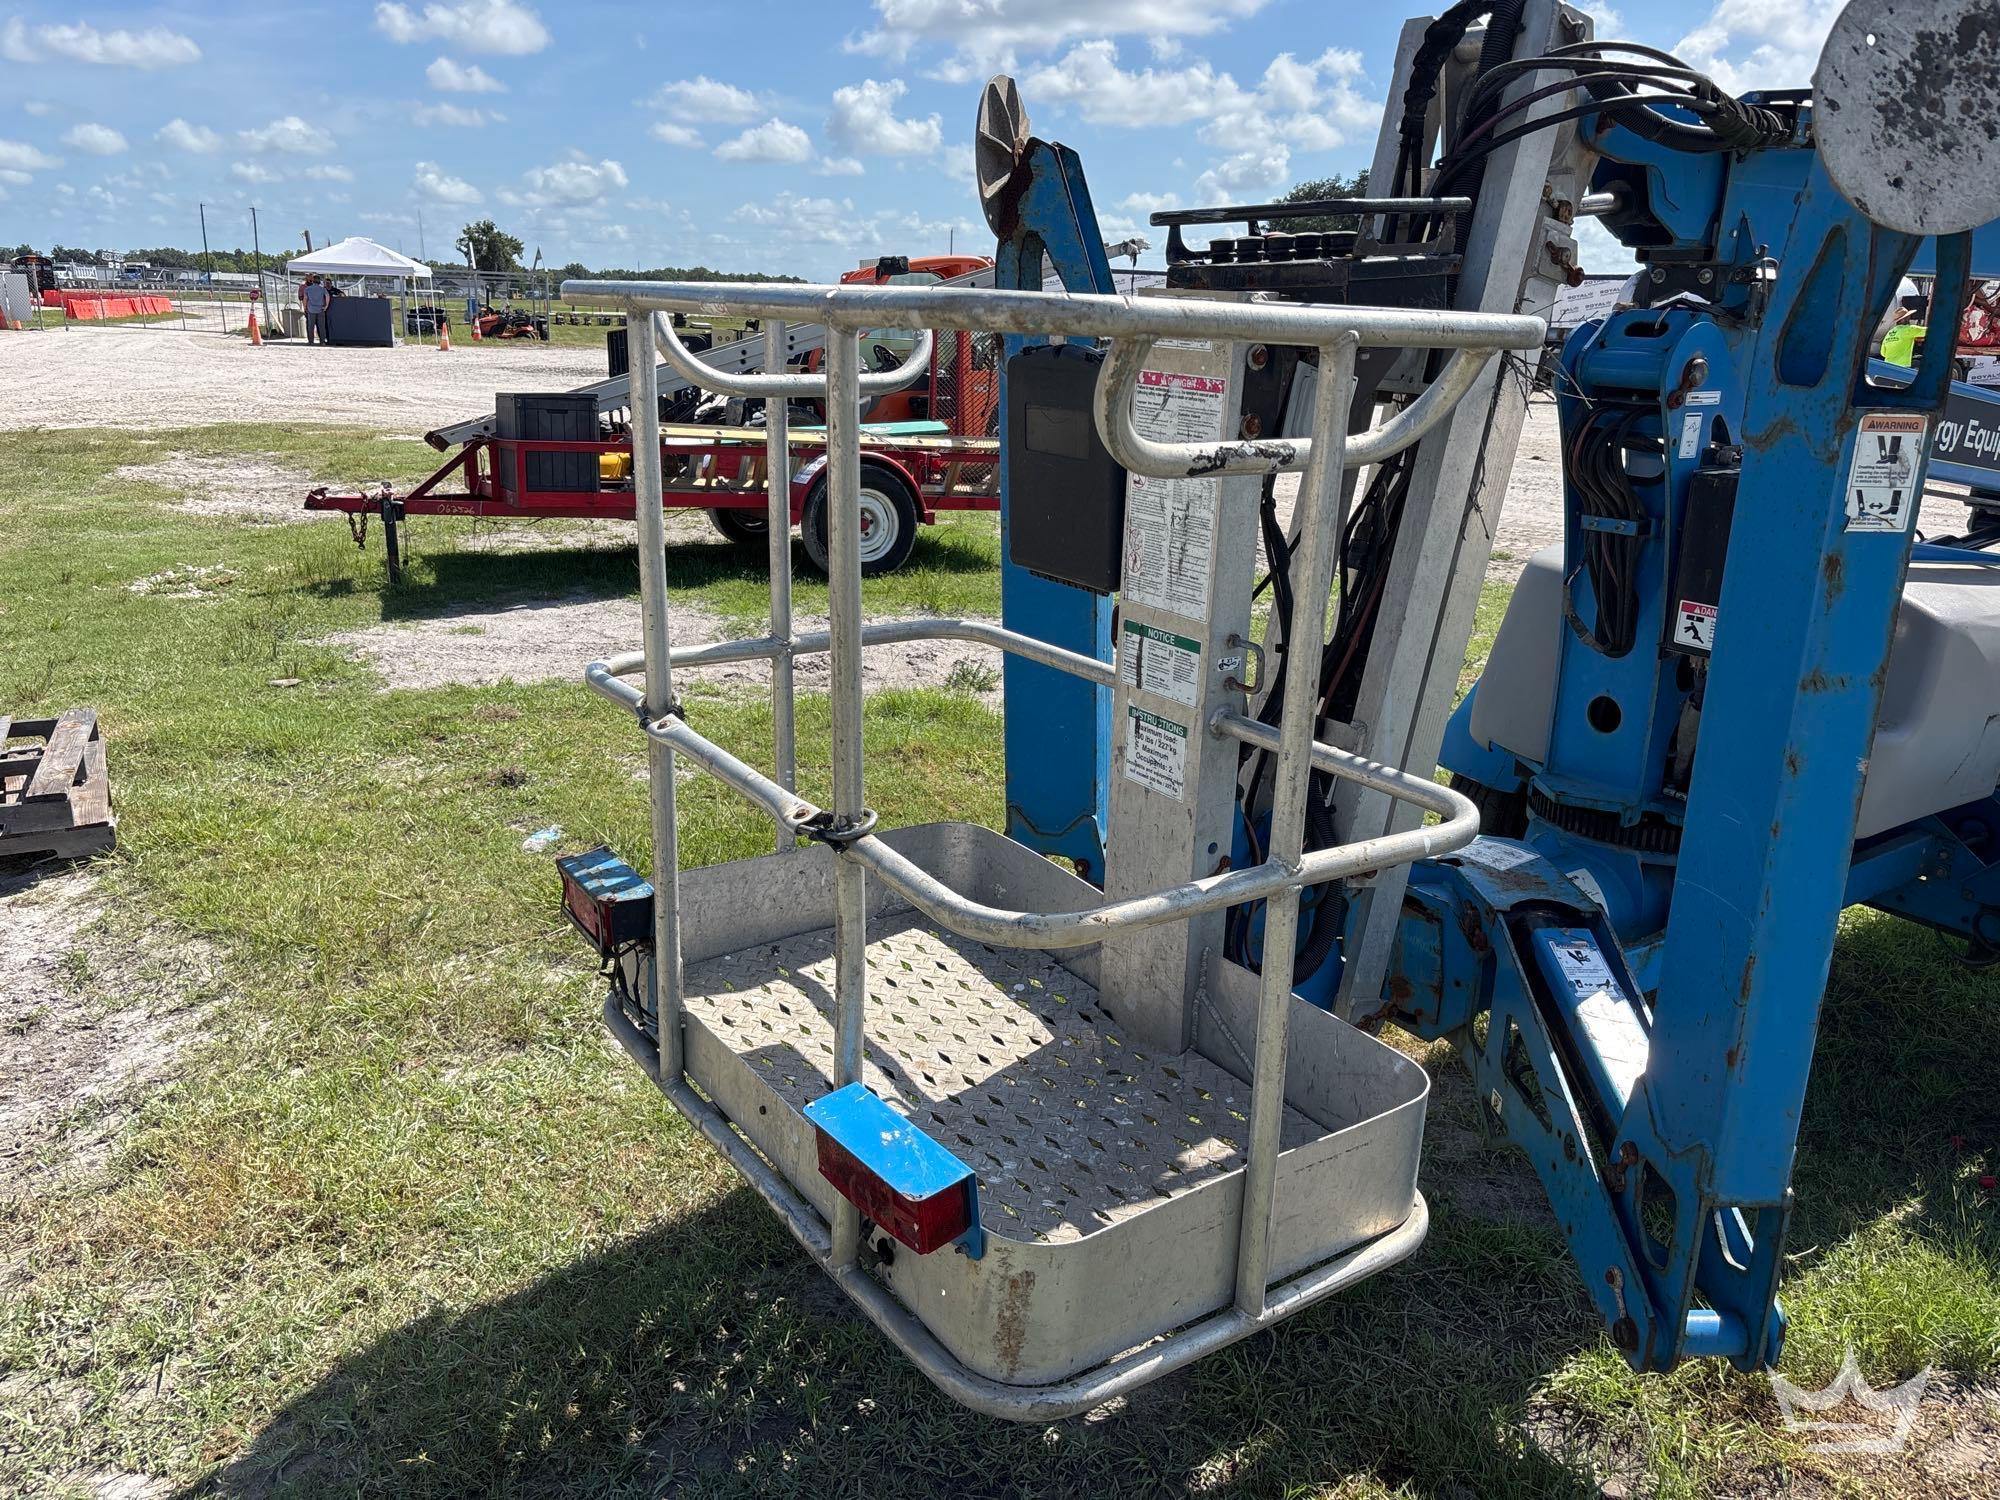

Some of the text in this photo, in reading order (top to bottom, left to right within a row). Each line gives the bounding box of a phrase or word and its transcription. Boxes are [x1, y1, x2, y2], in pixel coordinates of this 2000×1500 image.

[1875, 421, 1919, 430] WARNING
[1147, 628, 1176, 645] NOTICE
[1135, 723, 1163, 739] aximum
[1141, 744, 1169, 762] Maximum
